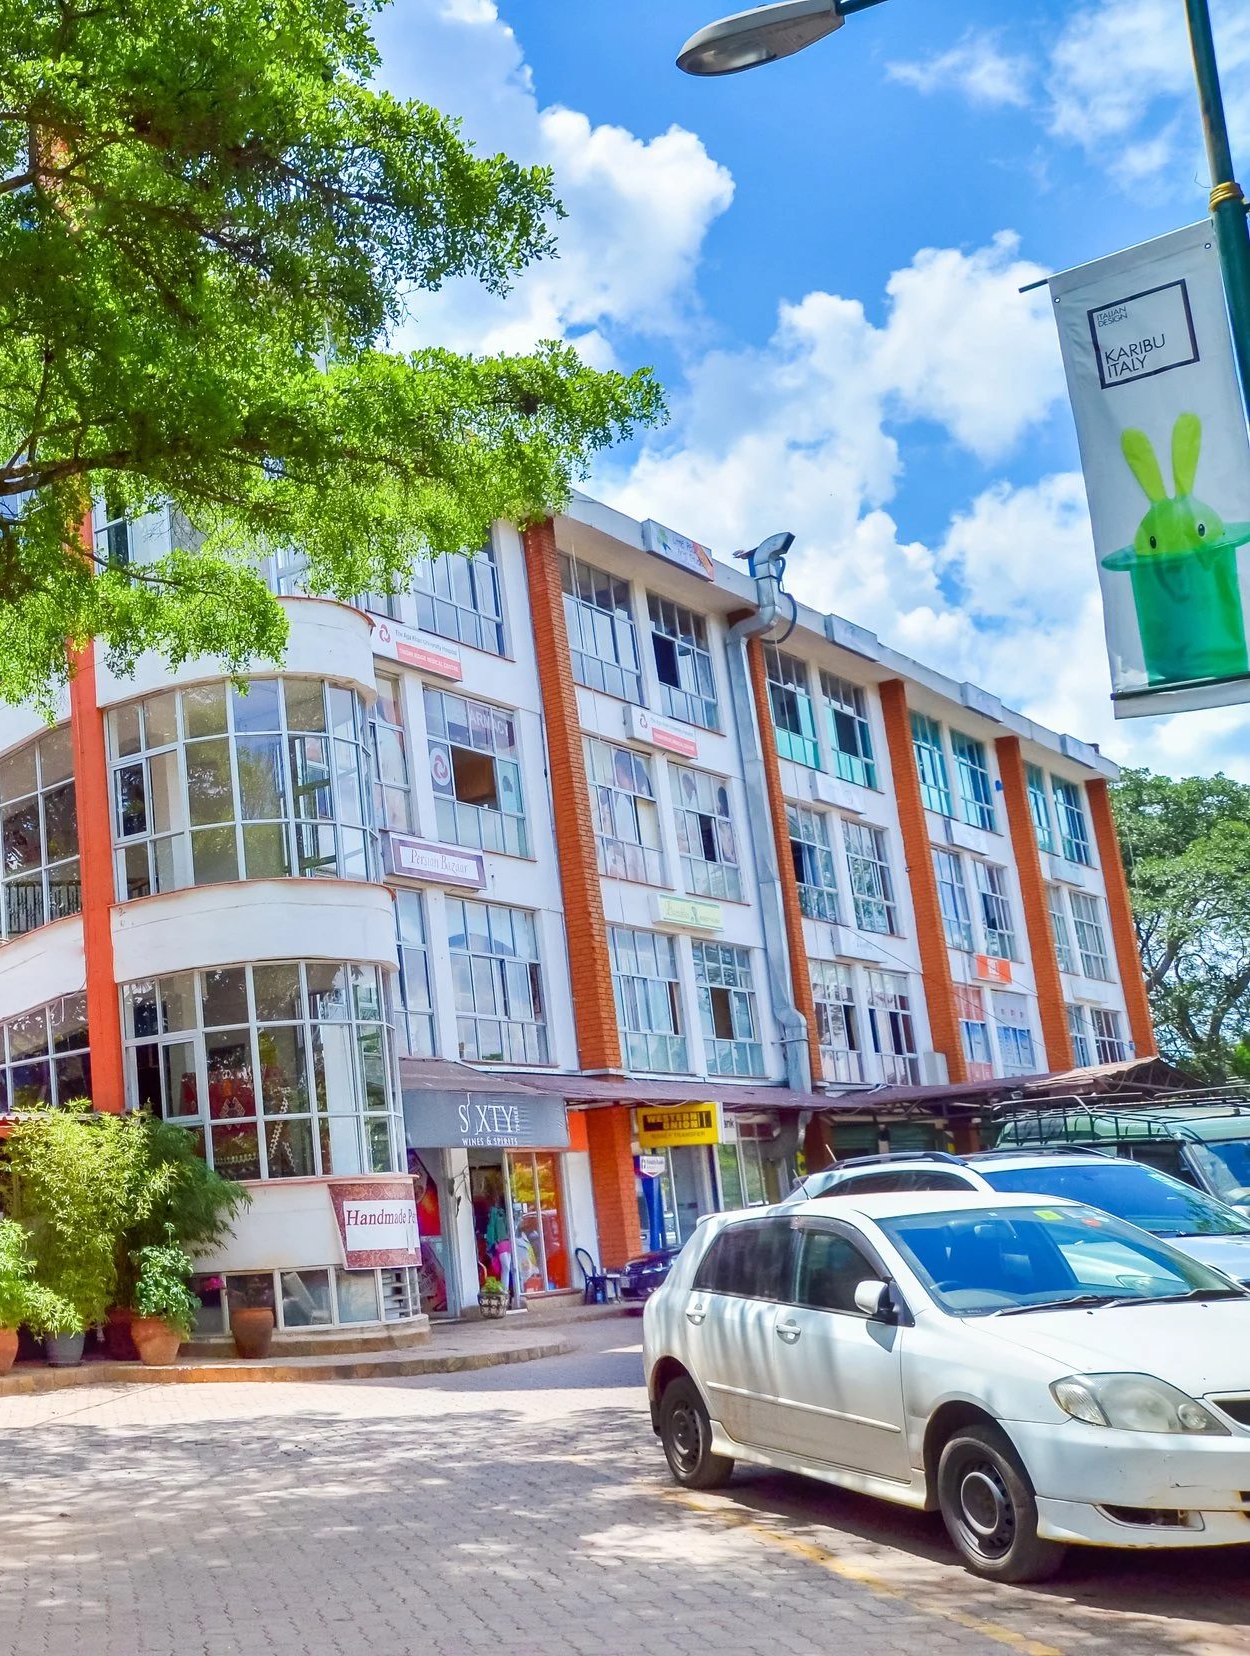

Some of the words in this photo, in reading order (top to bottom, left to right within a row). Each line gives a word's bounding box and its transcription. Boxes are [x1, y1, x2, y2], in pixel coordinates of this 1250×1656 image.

[1097, 306, 1127, 320] ITALIAN
[1098, 313, 1128, 327] DESIGN
[1104, 333, 1166, 365] KARIBU
[1107, 355, 1147, 378] ITALY
[411, 848, 439, 868] Persian
[441, 855, 468, 874] Bazaar
[646, 1111, 699, 1123] WESTERN
[662, 1120, 699, 1131] UNION
[461, 1137, 484, 1146] WINES
[486, 1136, 492, 1146] &
[493, 1137, 518, 1146] SPIRITS
[673, 1130, 706, 1138] TRANSFER
[346, 1208, 407, 1226] Handmade
